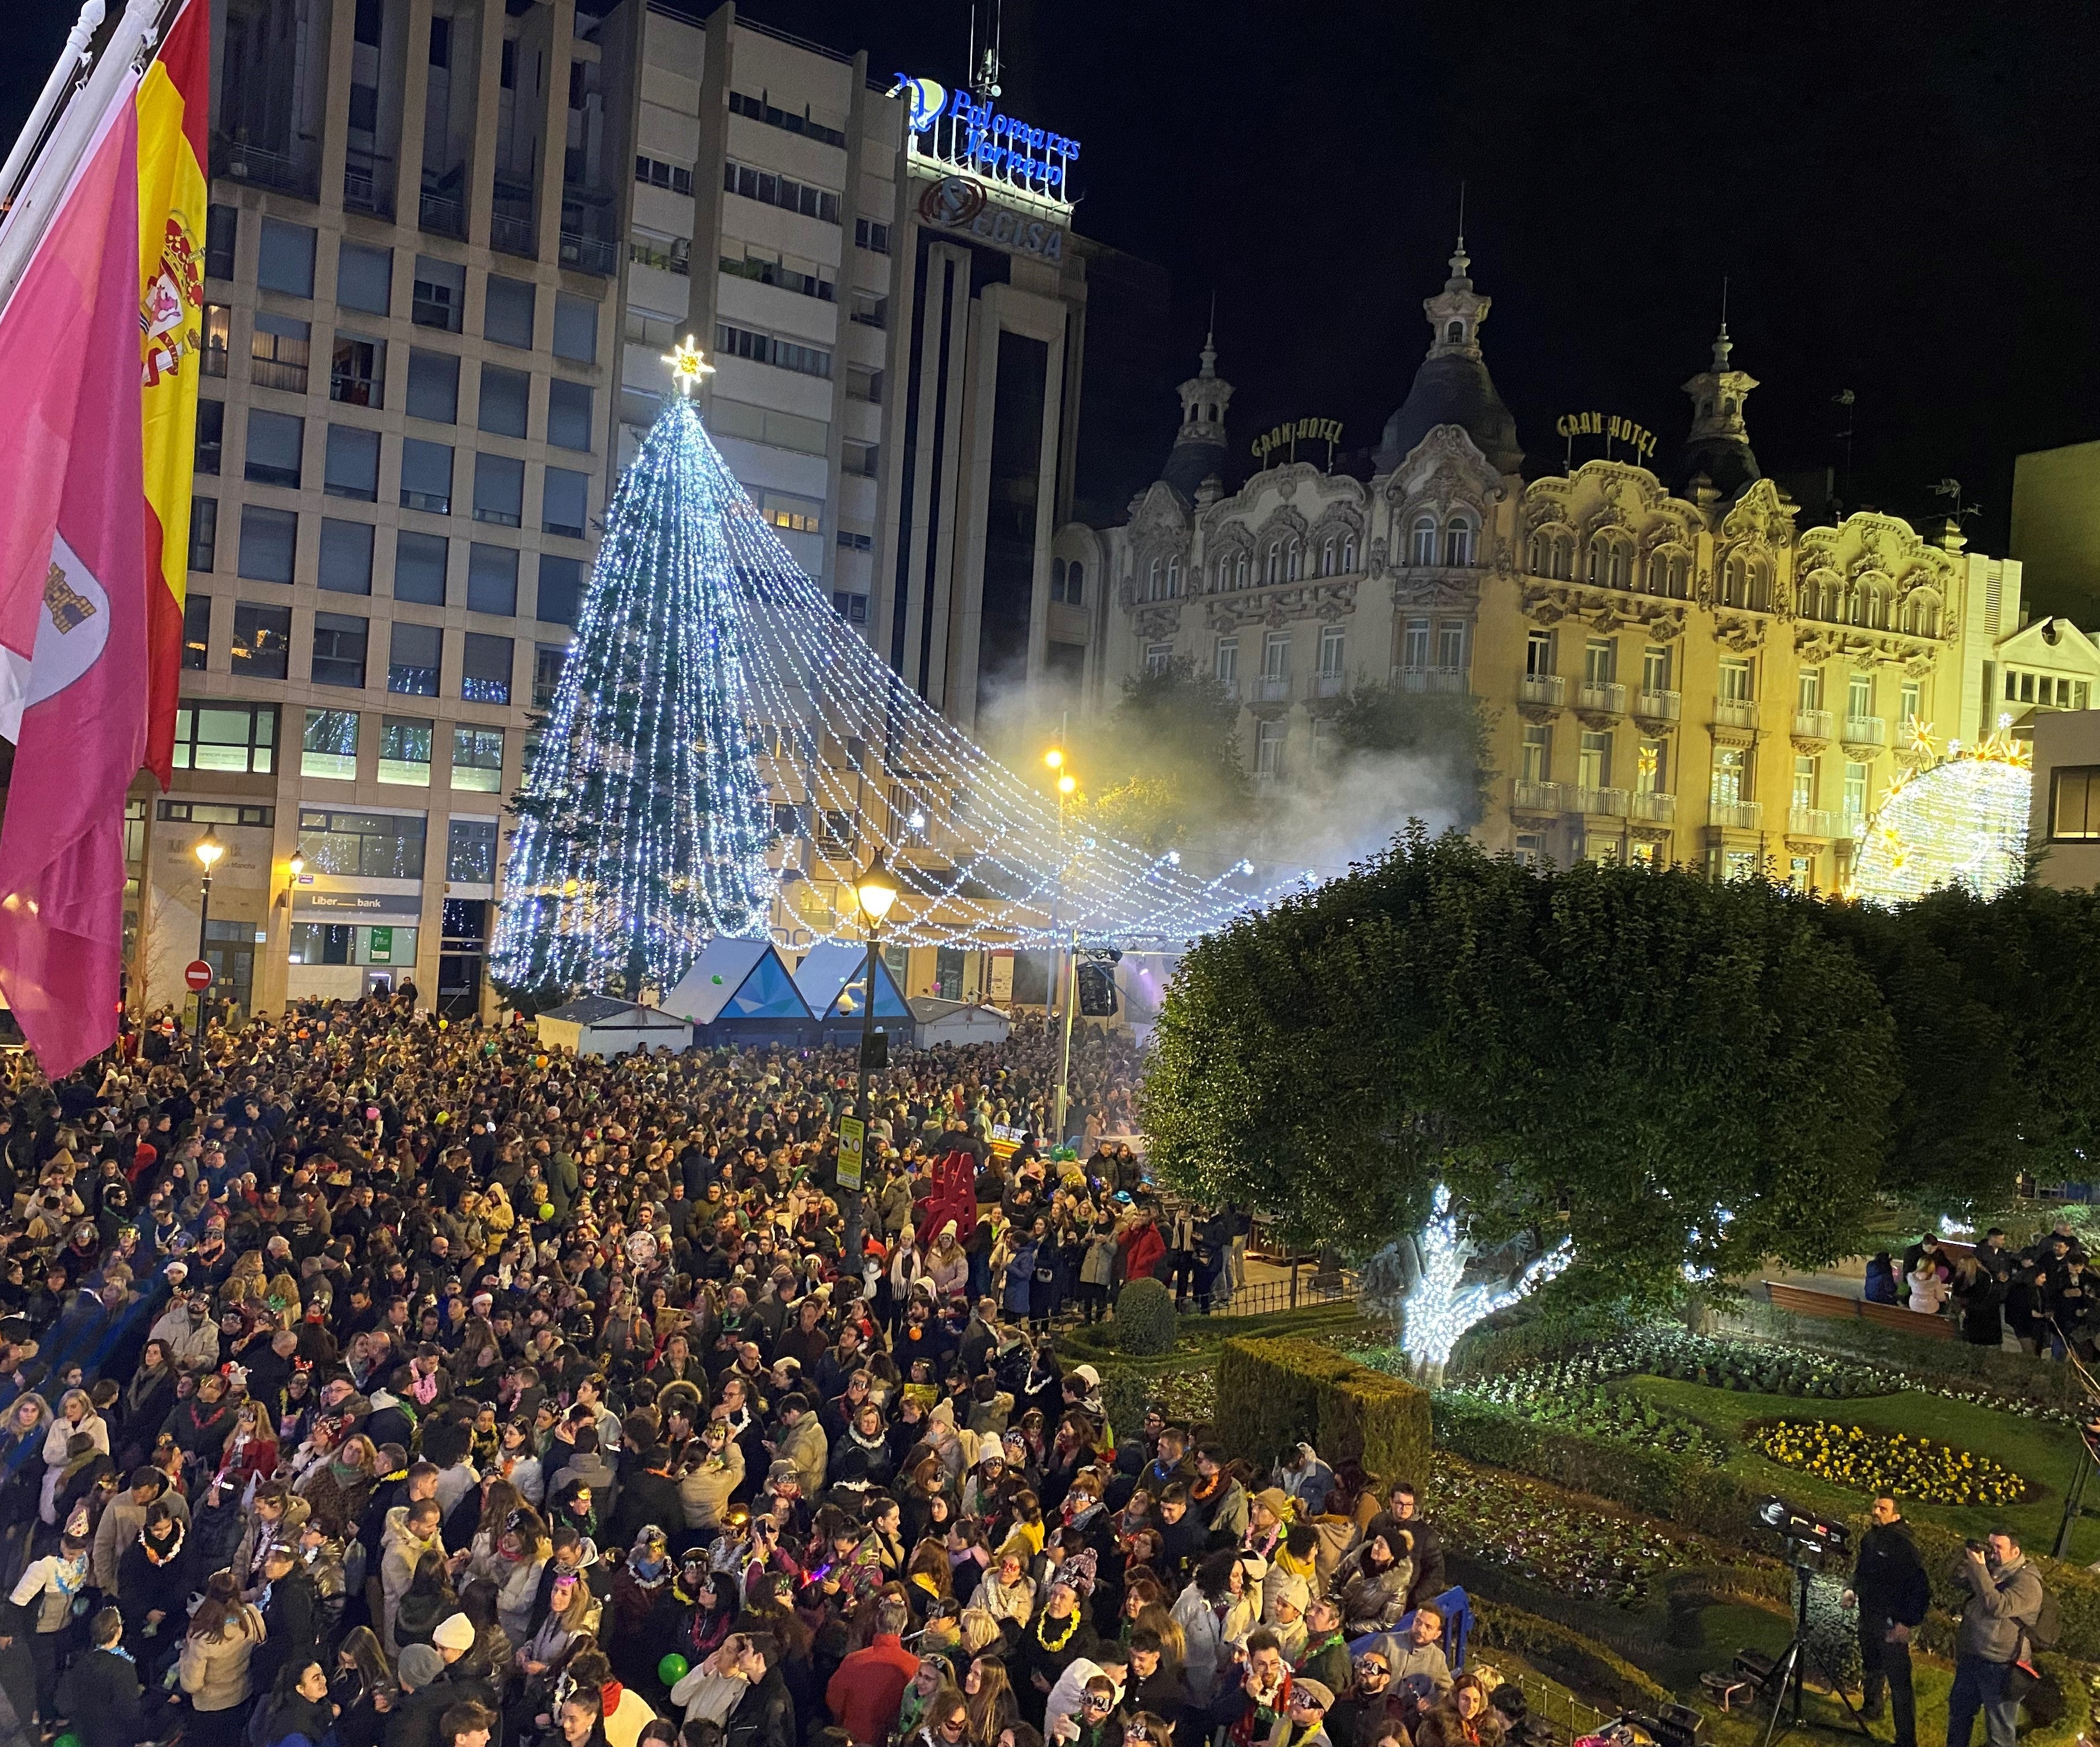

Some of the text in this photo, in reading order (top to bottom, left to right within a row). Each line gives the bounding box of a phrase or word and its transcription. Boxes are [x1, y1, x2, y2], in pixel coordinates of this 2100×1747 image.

[948, 88, 1081, 161] Palomares
[1251, 417, 1344, 457] GRAN HOTEL
[1556, 411, 1657, 458] GRAN HOTEL
[312, 896, 381, 908] Liber bank
[1078, 1689, 1110, 1711] 2024
